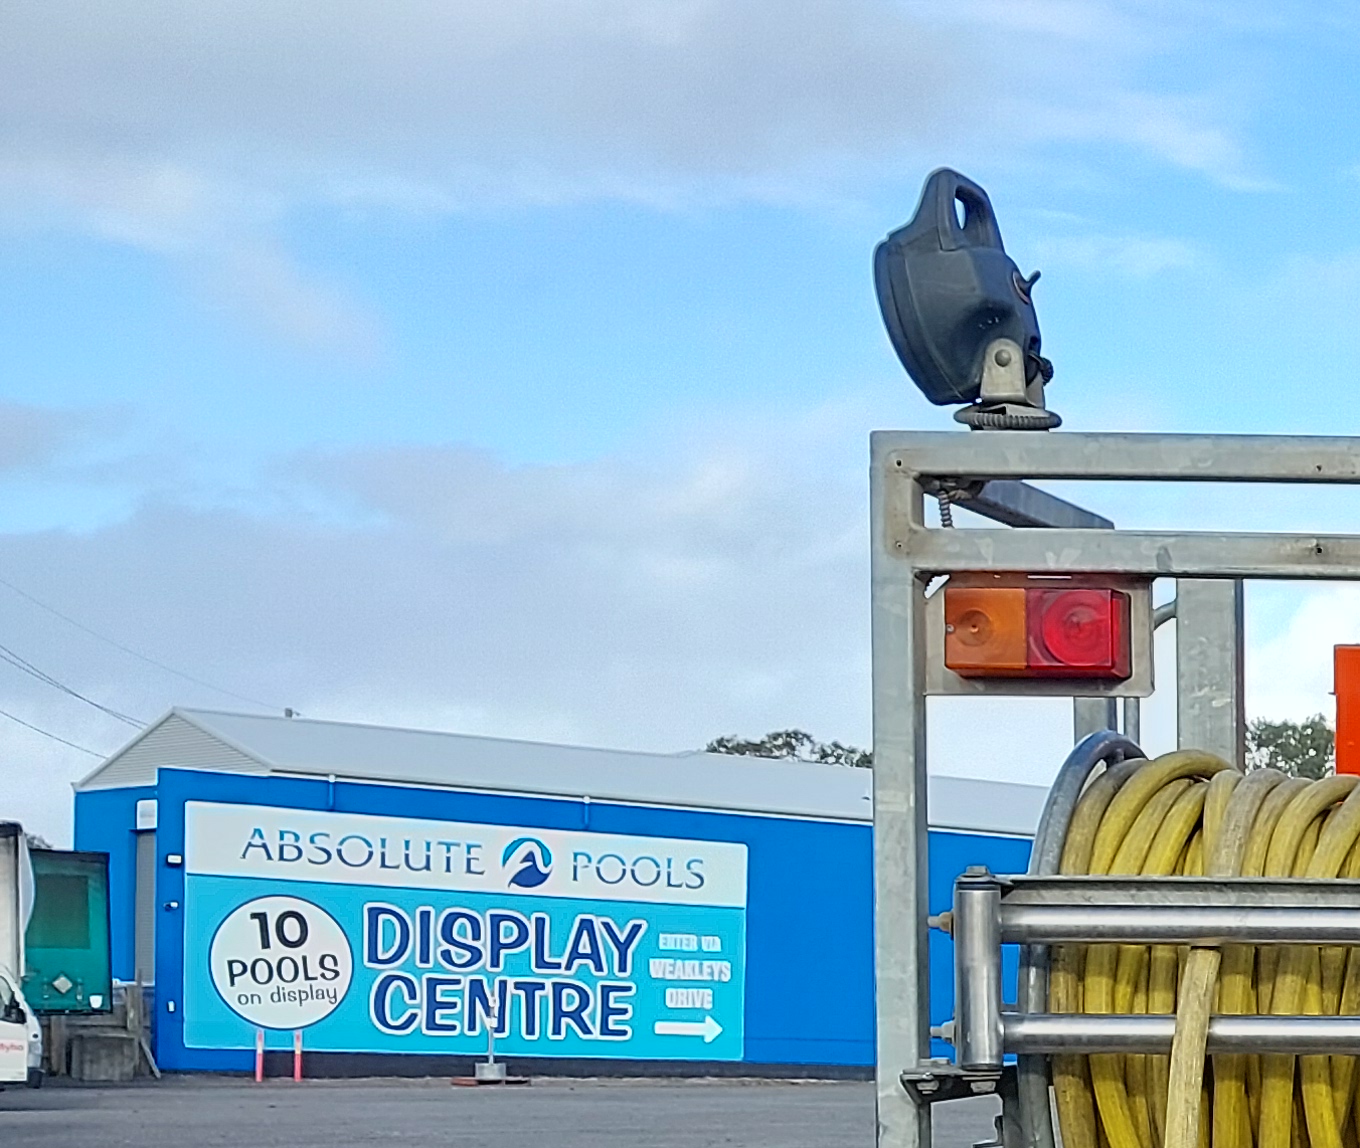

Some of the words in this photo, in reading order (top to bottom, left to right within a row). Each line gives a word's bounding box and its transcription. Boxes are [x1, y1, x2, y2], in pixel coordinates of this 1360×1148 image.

[240, 827, 485, 875] ABSOLUTE
[571, 851, 705, 890] POOLS
[249, 910, 309, 950] 10
[364, 903, 646, 976] DISPLAY
[659, 933, 698, 950] ENTER
[701, 935, 722, 952] VIA
[227, 953, 340, 987] POOLS
[650, 957, 732, 983] WEAKLEYS
[237, 993, 262, 1006] on
[270, 983, 338, 1007] display
[371, 972, 635, 1039] CENTRE
[665, 987, 713, 1009] DRIVE
